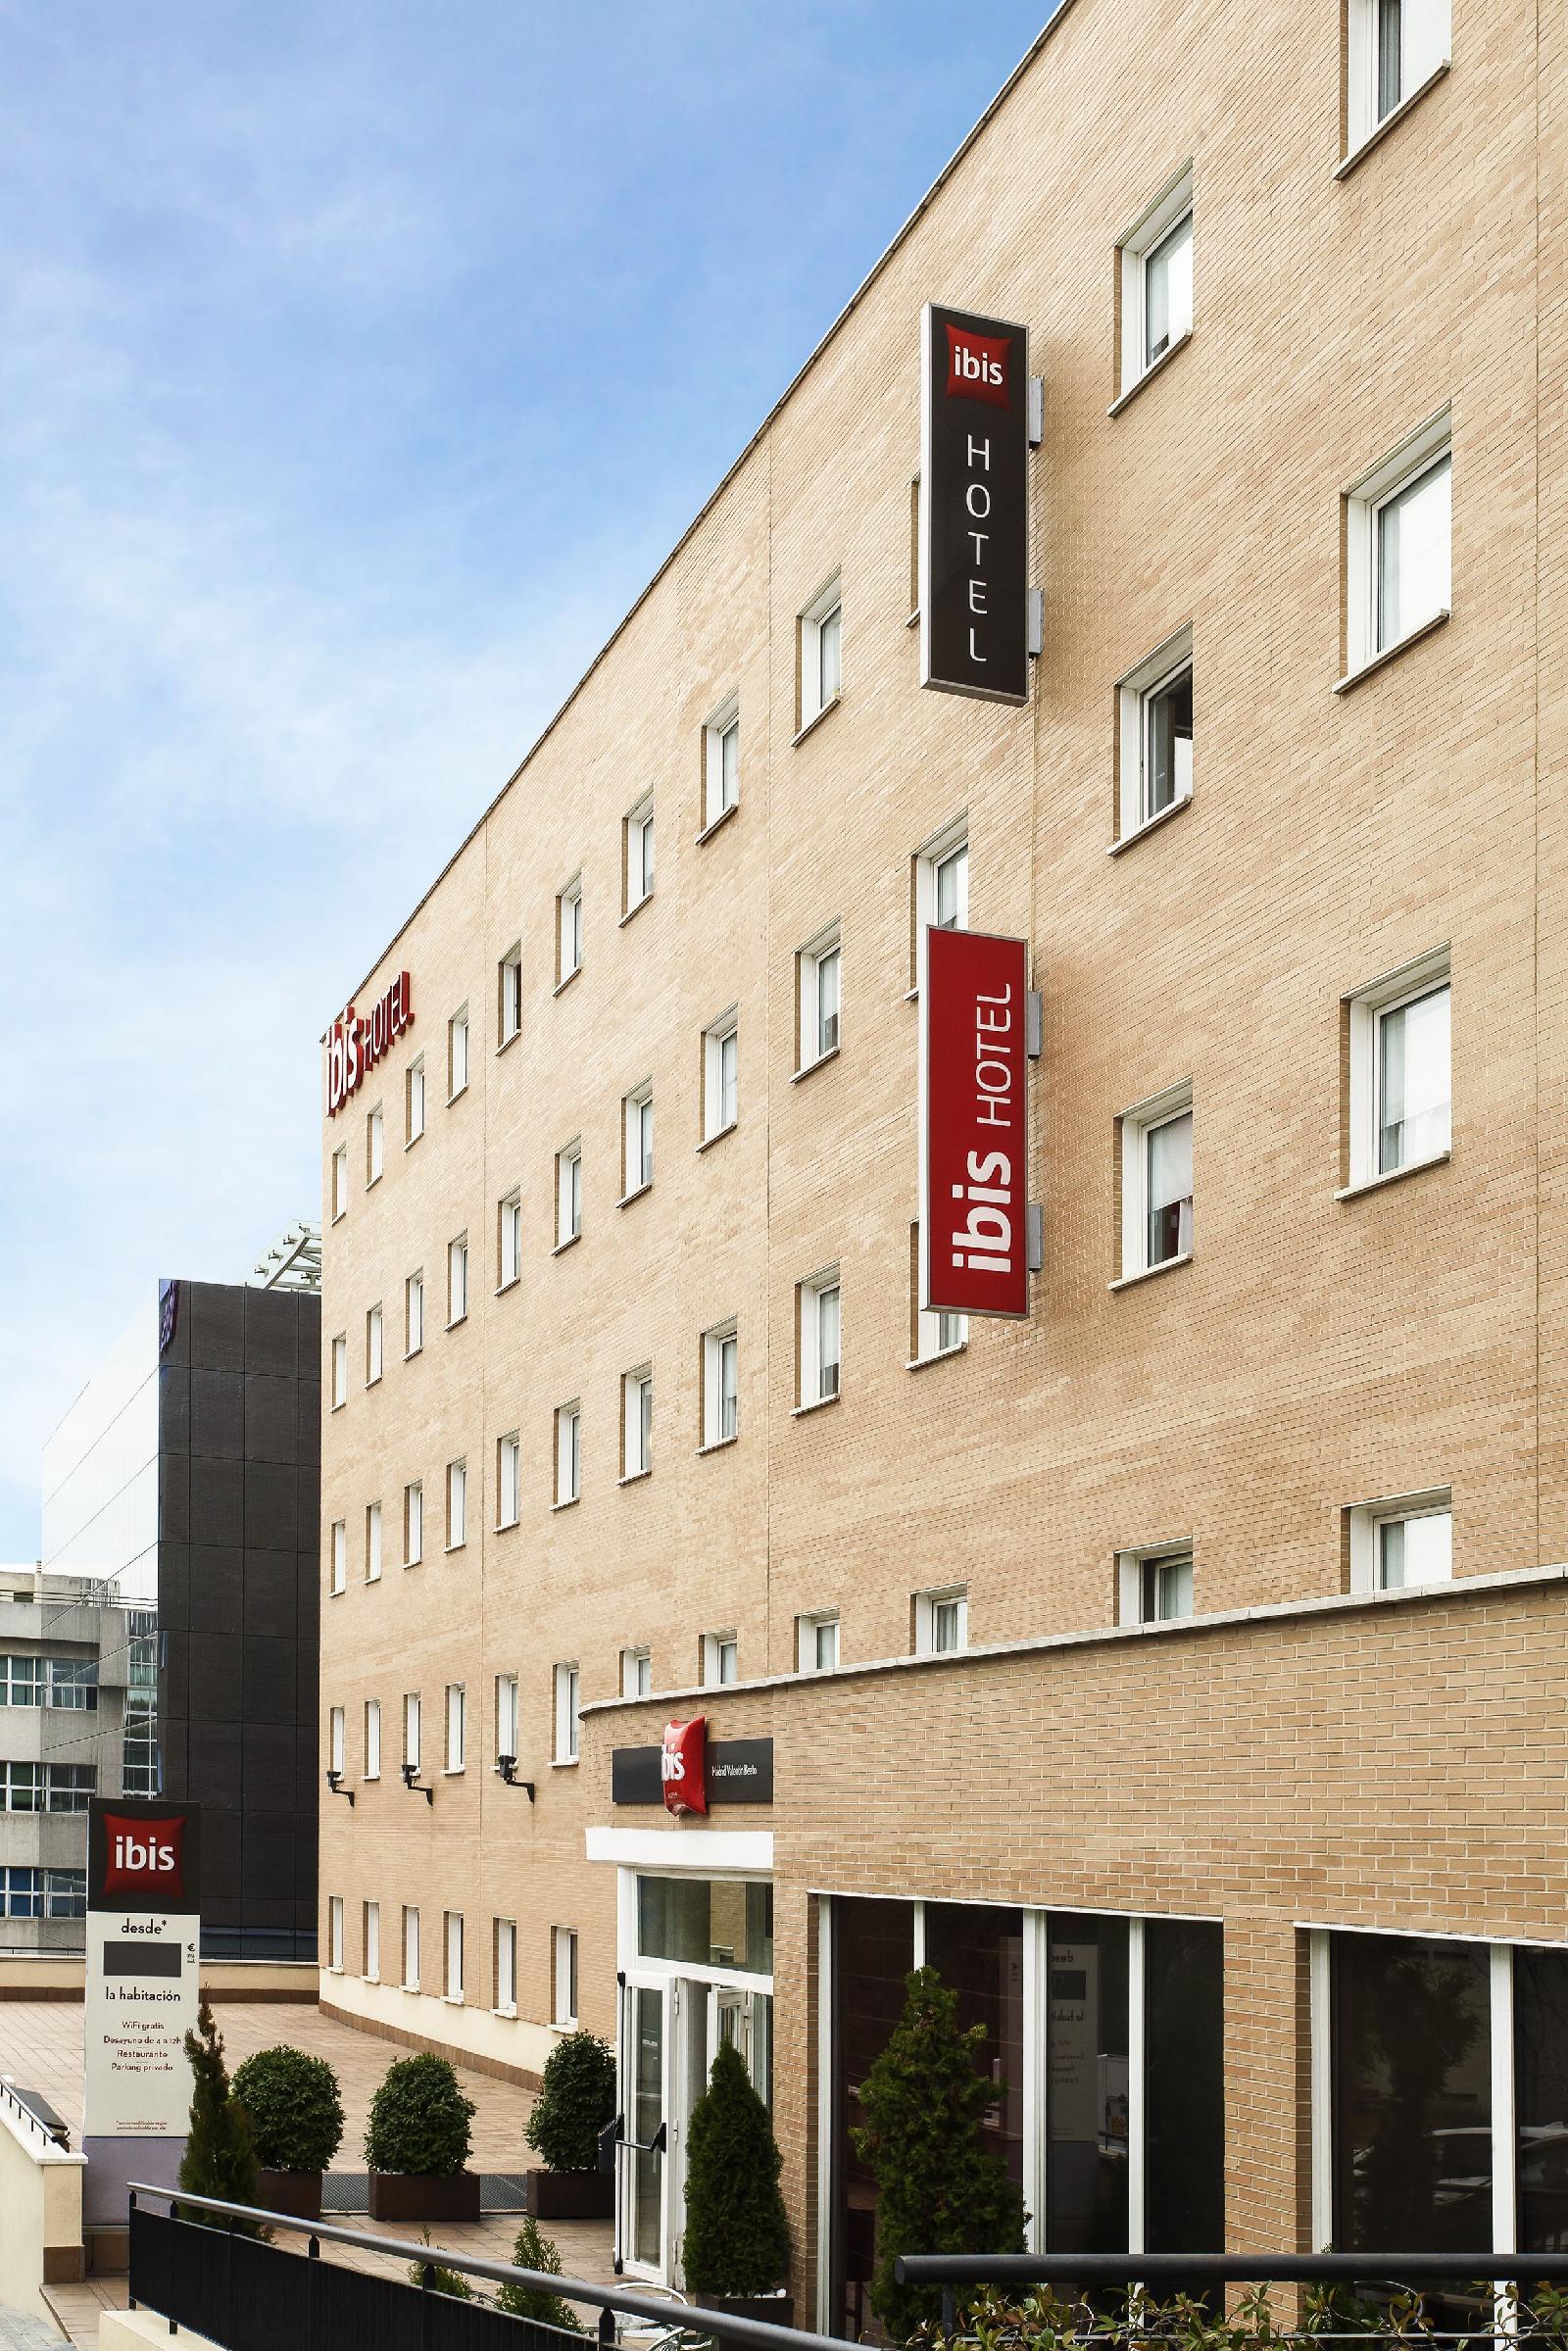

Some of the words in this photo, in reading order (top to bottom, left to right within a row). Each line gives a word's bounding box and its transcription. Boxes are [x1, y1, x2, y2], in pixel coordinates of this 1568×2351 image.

[954, 346, 1004, 385] ibis
[965, 433, 991, 662] HOTEL
[325, 1004, 364, 1118] ibis
[364, 970, 415, 1072] HOTEL
[976, 983, 1011, 1127] HOTEL
[952, 1151, 1012, 1273] ibis
[116, 1836, 174, 1871] ibis
[106, 1986, 116, 2000] la
[120, 1985, 181, 2001] habitación
[103, 2034, 143, 2044] Desayuno
[144, 2035, 154, 2044] de
[122, 2021, 140, 2030] WiFi
[141, 2022, 165, 2031] gratis
[111, 2062, 141, 2072] Parking
[143, 2063, 173, 2072] privado
[117, 2049, 169, 2058] Restaurante
